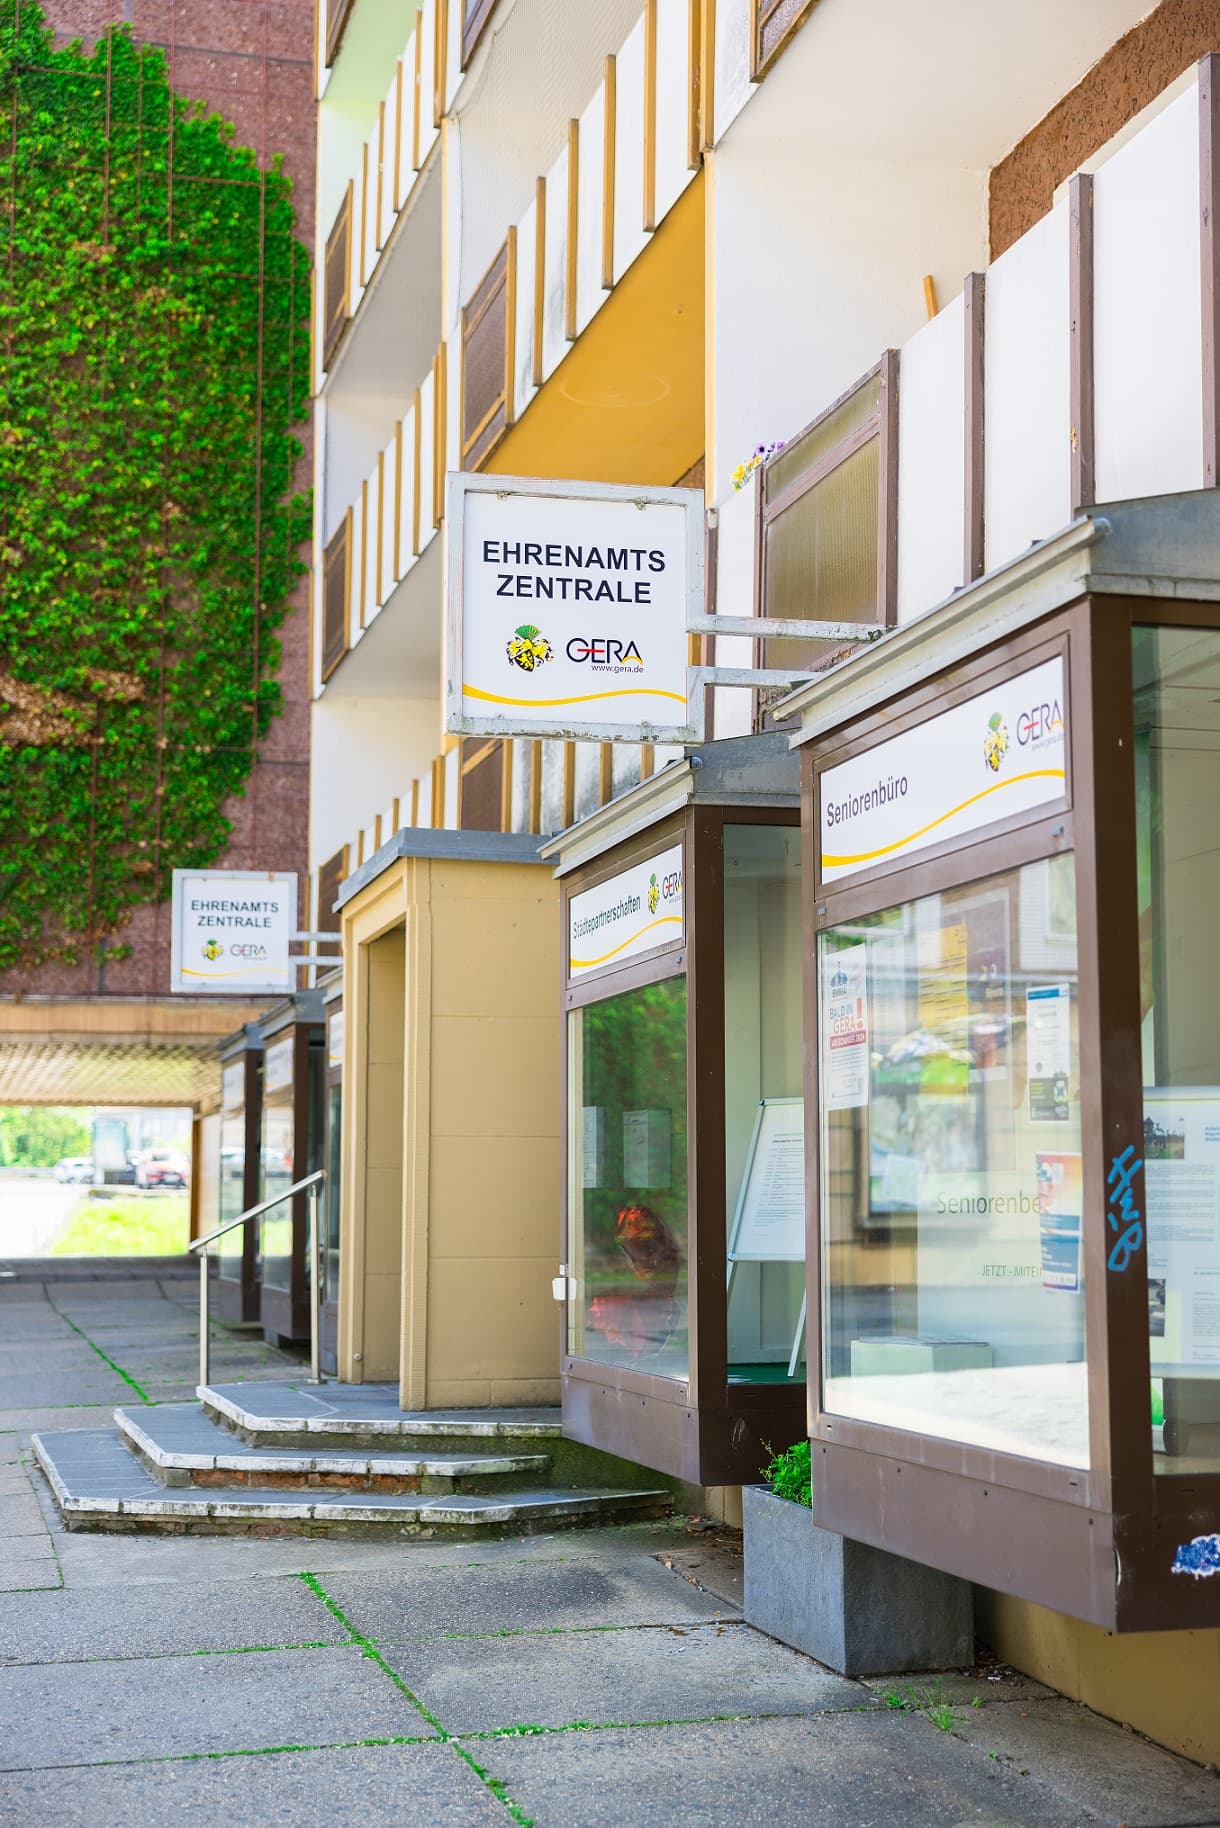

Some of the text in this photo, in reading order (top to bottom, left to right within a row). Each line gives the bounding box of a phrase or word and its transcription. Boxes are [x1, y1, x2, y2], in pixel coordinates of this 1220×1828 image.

[483, 540, 666, 573] EHRENAMTS
[496, 574, 651, 604] ZENTRALE
[566, 637, 644, 665] GERA
[591, 664, 644, 674] www.gera.de
[1017, 698, 1064, 746] GERA
[826, 775, 908, 828] Seniorenbüro
[191, 899, 279, 913] EHRENAMTS
[573, 895, 641, 939] Städtepartnerschaften
[198, 915, 272, 928] ZENTRALE
[230, 944, 267, 957] GERA
[982, 1264, 1007, 1278] JETZT
